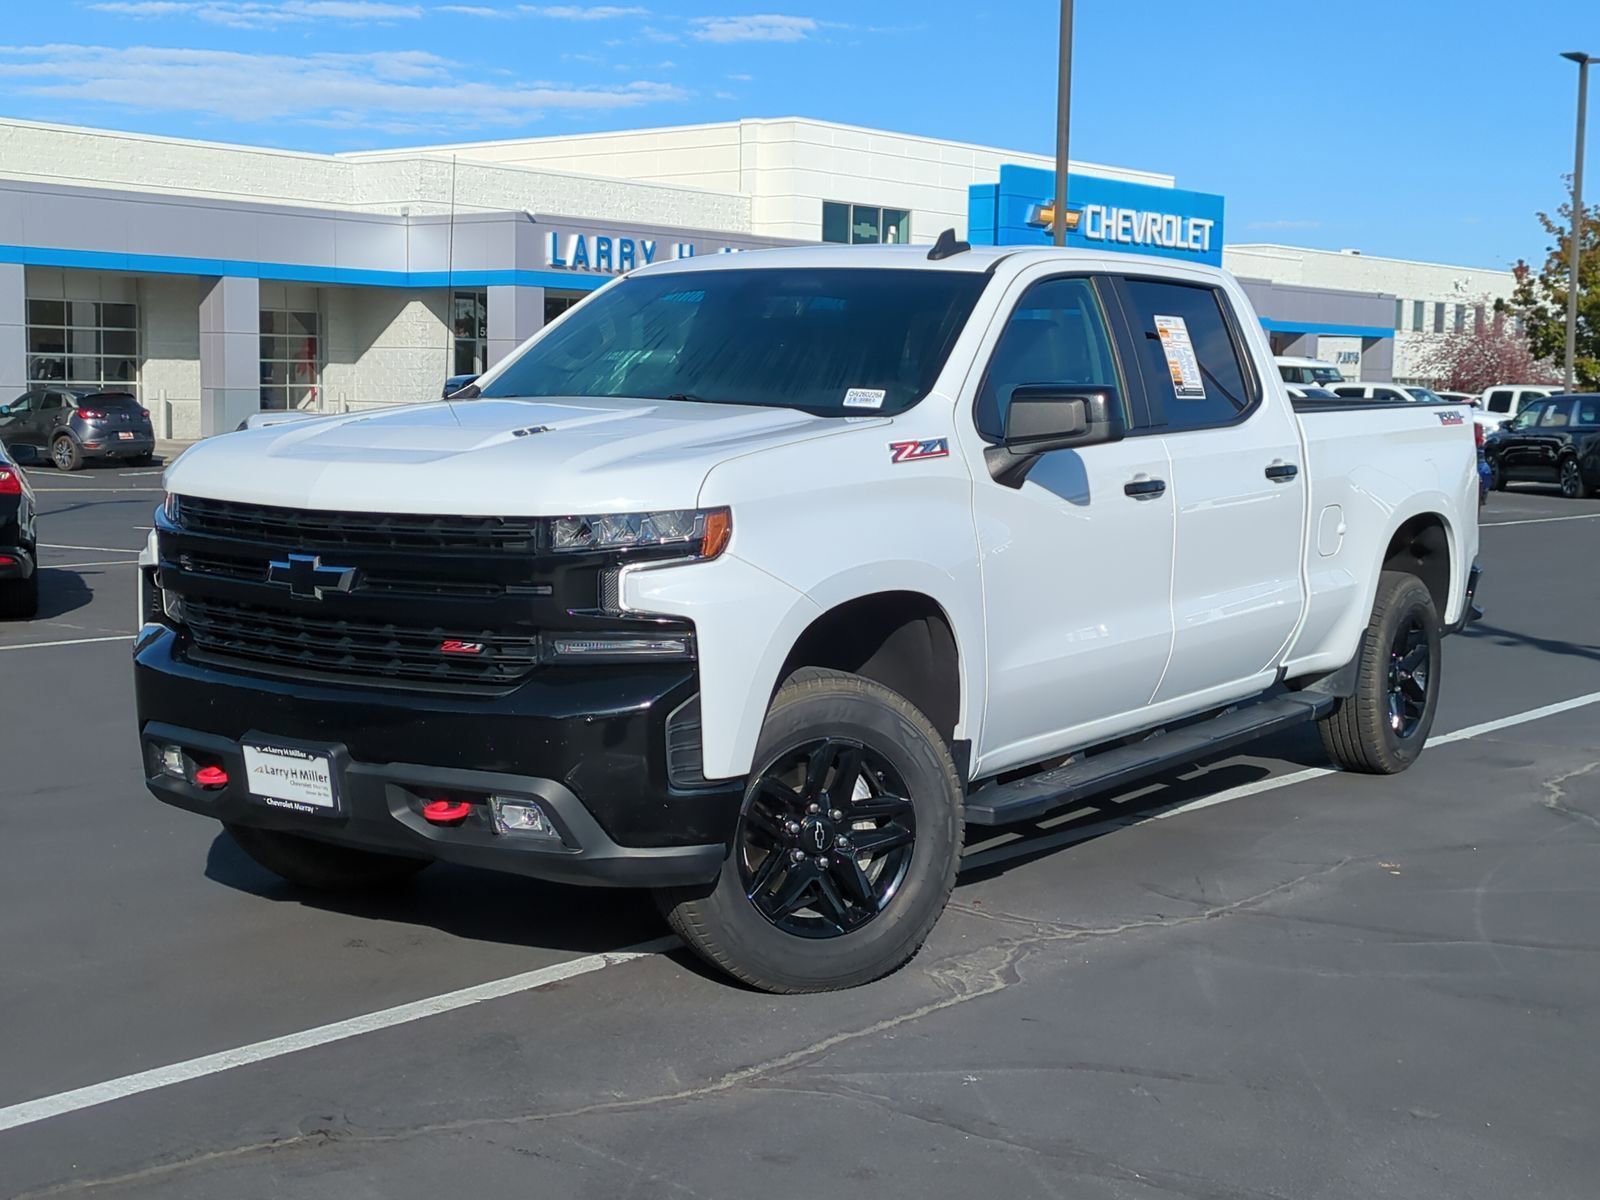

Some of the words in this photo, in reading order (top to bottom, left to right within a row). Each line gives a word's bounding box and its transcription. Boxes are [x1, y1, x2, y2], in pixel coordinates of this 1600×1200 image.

[1085, 204, 1214, 251] CHEVROLET
[547, 231, 657, 270] LARRY
[889, 437, 949, 463] Z71
[440, 640, 483, 653] Z71
[264, 764, 289, 780] Larry
[290, 768, 298, 779] H
[300, 769, 328, 783] Miller
[266, 798, 294, 809] Chevrolet
[294, 802, 314, 814] Murray
